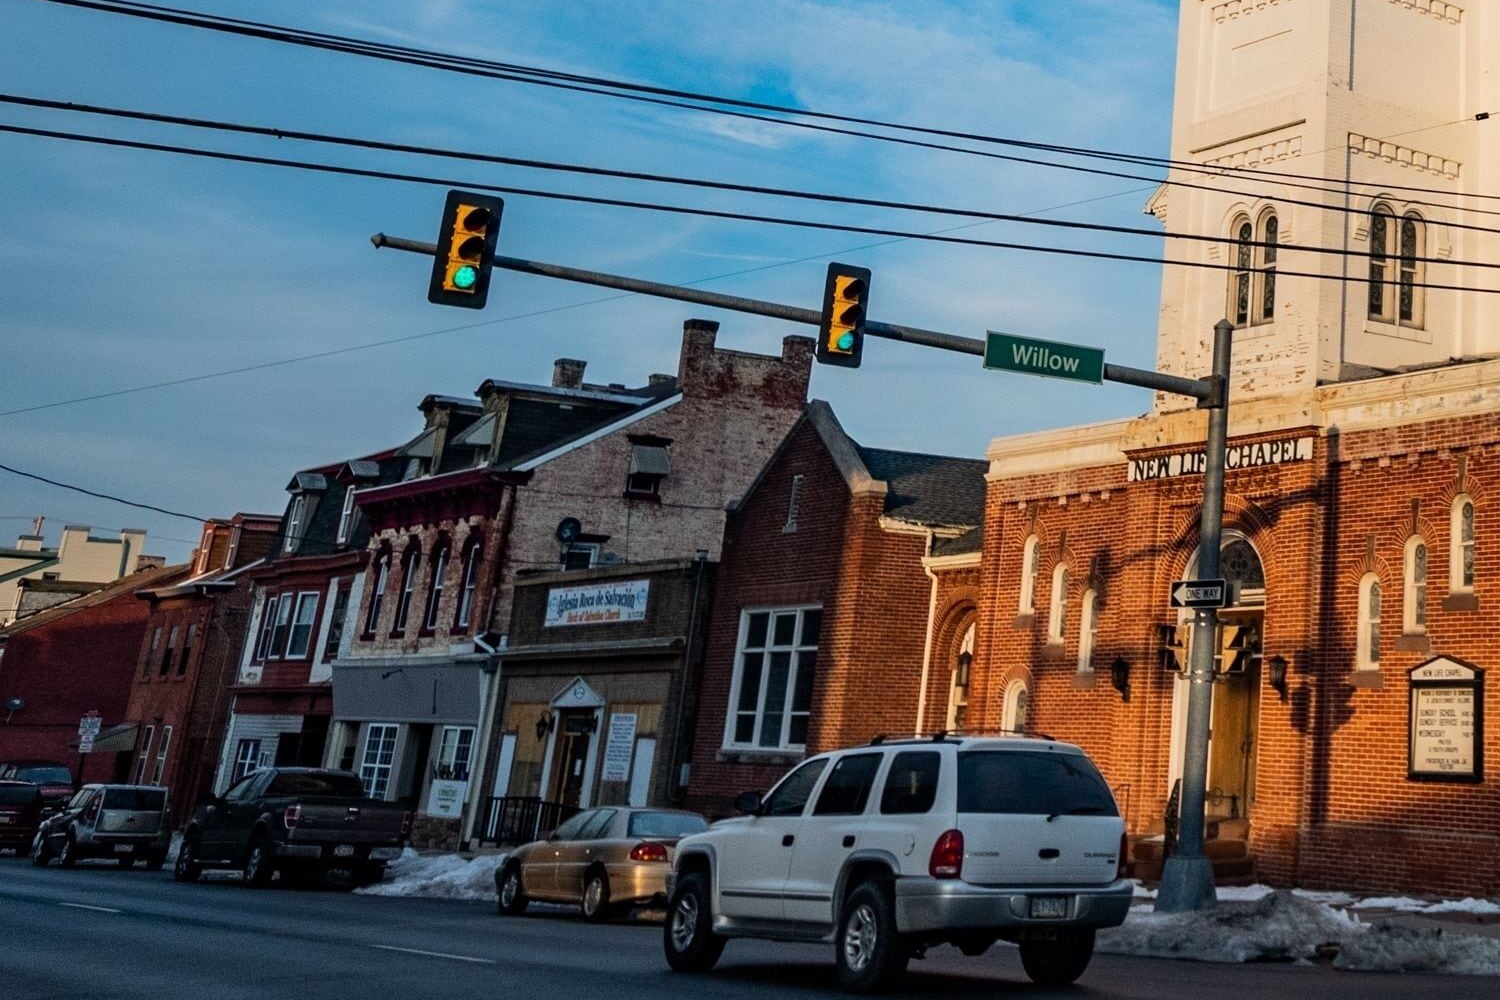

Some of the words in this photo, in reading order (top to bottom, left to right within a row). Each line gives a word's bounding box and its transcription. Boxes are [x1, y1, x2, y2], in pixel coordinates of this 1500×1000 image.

[1012, 343, 1080, 373] Willow
[1133, 455, 1172, 481] NEW
[1179, 452, 1208, 476] LIF
[1226, 439, 1305, 469] CHAPEL
[557, 592, 579, 618] Iglesia
[579, 592, 595, 607] Roca
[595, 590, 604, 606] de
[1186, 588, 1201, 600] ONE
[1203, 588, 1219, 600] WAY
[1422, 669, 1432, 677] NEW
[1434, 668, 1444, 677] LIFE
[1445, 668, 1463, 677] CHAPEL
